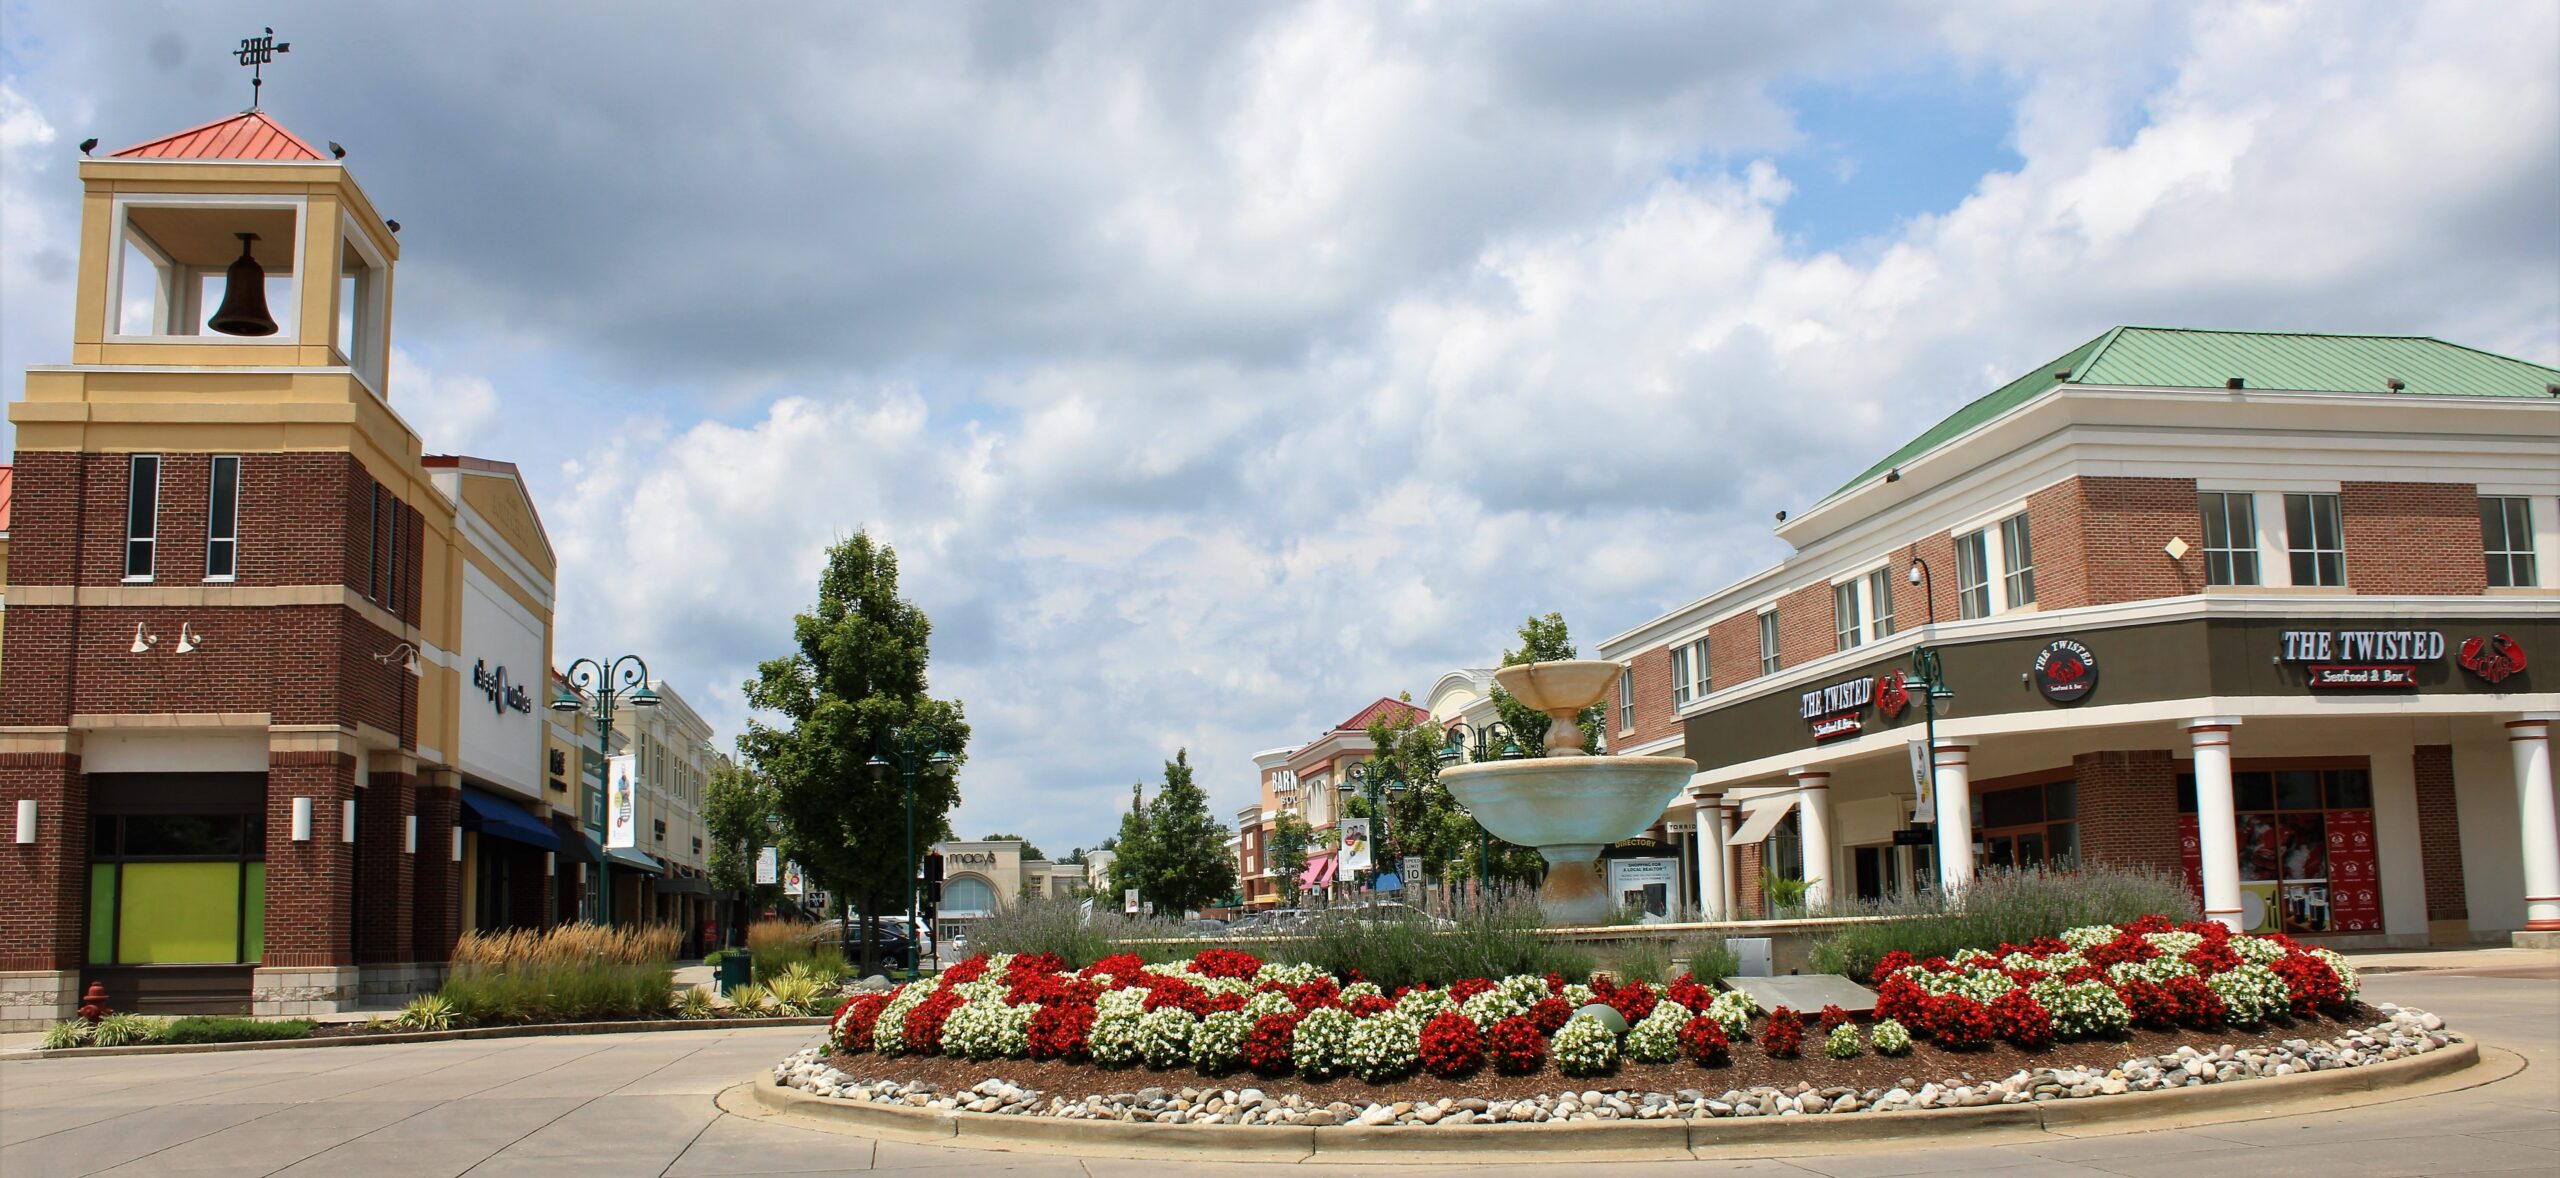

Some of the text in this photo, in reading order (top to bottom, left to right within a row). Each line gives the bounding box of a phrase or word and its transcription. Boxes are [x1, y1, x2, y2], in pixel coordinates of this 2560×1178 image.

[2284, 630, 2445, 660] THE TWISTED
[2035, 640, 2093, 671] THE TWISTED
[2322, 669, 2404, 682] Seafood & Bar
[1802, 690, 1822, 719] THE
[1824, 677, 1874, 713] TWISTED
[1615, 839, 1656, 848] DIRECTORY
[949, 851, 996, 865] macy's
[1407, 869, 1419, 879] 10
